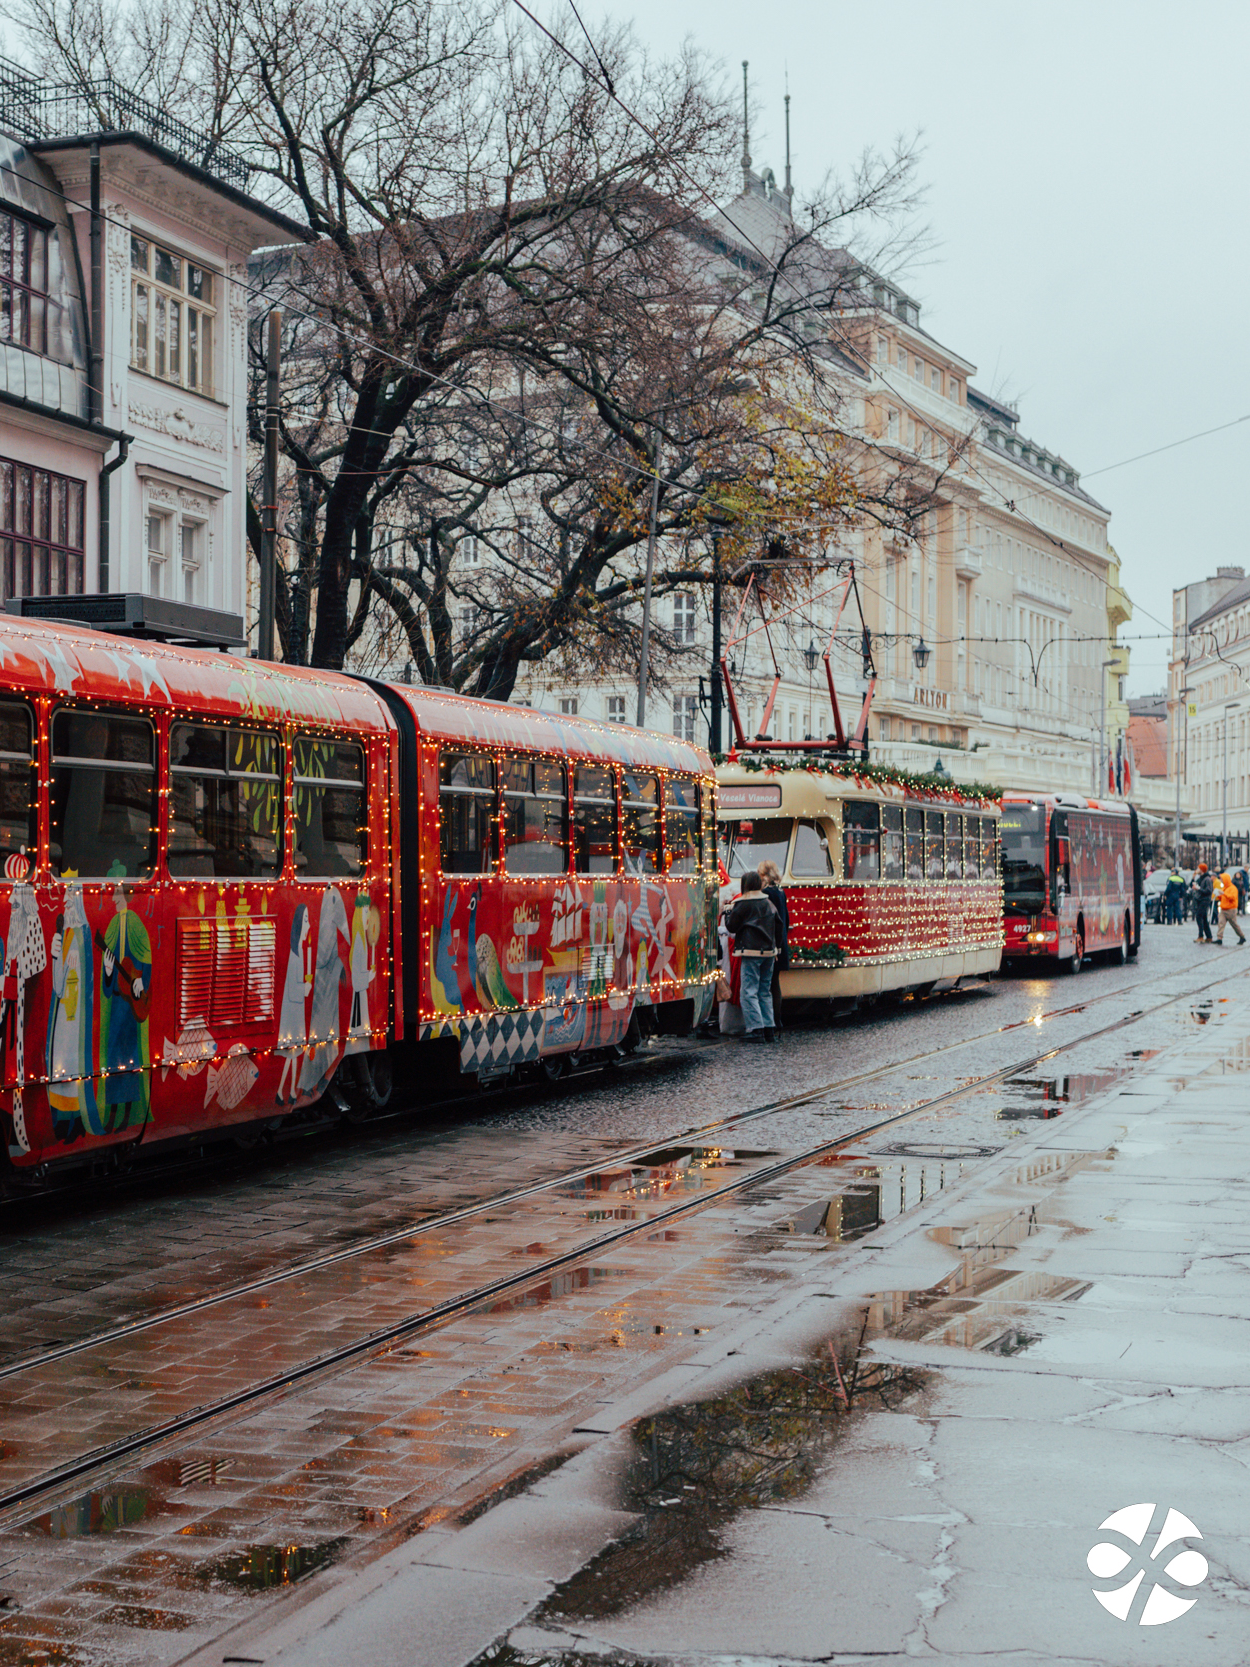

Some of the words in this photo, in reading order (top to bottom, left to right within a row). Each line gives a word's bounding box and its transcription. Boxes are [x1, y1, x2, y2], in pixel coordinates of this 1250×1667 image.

[720, 793, 746, 802] Veselé
[748, 793, 778, 803] Vianoce
[1013, 924, 1031, 933] 4927
